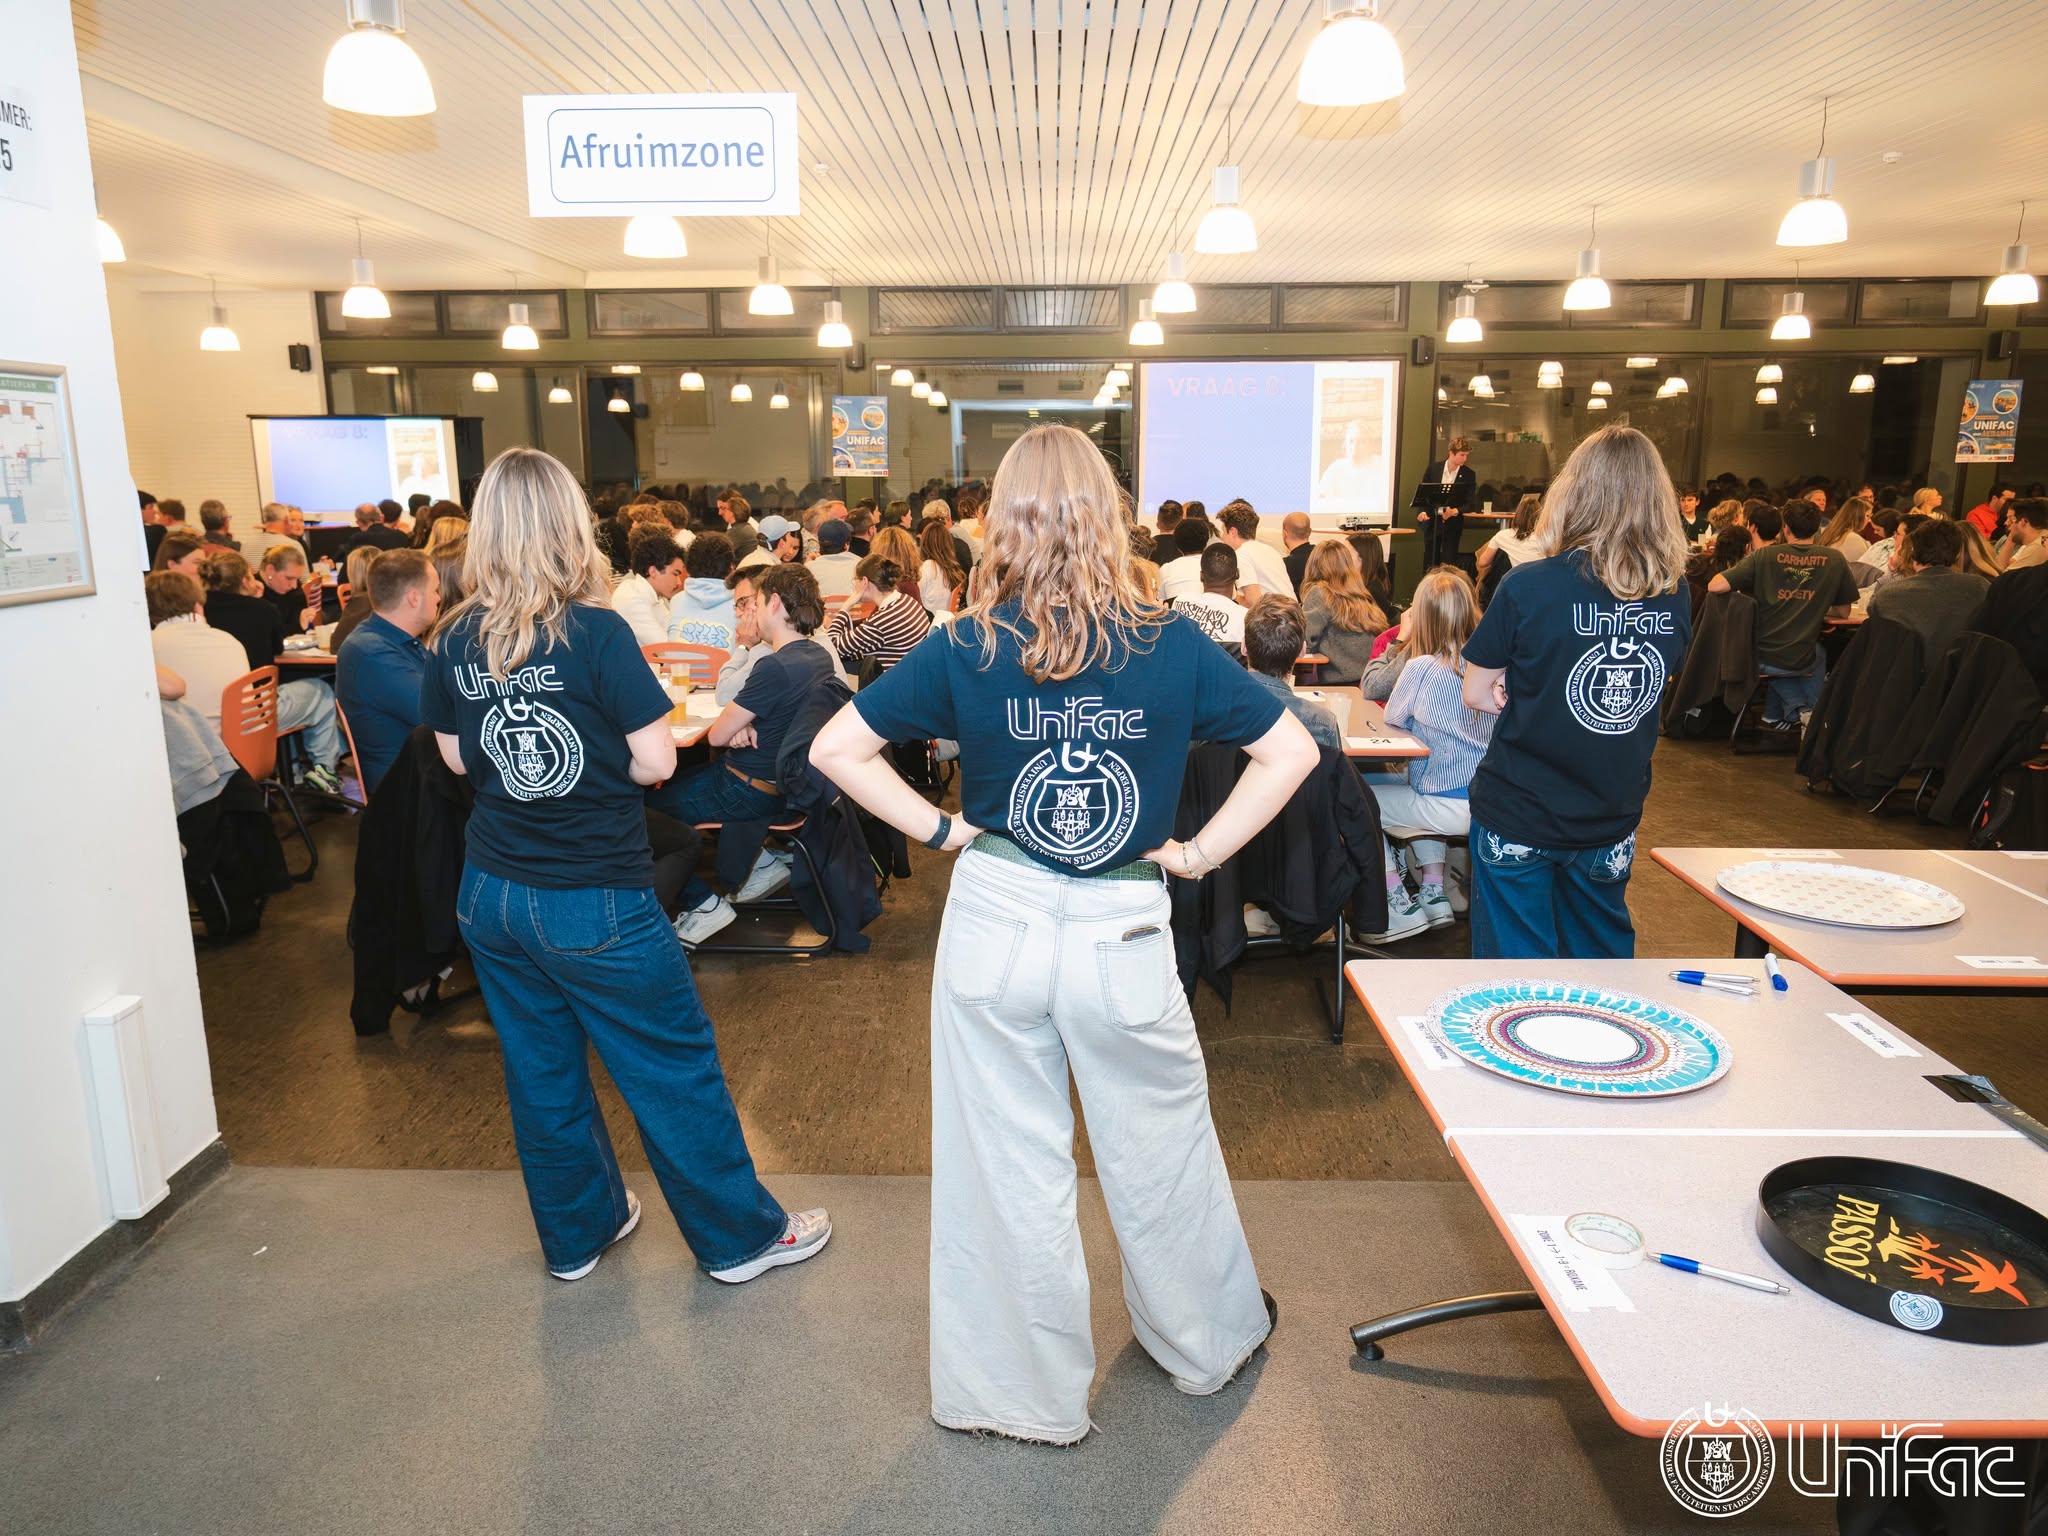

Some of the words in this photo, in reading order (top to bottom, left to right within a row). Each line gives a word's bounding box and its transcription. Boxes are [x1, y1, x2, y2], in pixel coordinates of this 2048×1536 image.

[0, 99, 33, 132] MER:
[560, 132, 765, 169] Afruimzone
[1168, 376, 1257, 397] VRAAG
[846, 436, 885, 445] UNIFAC
[1973, 421, 2015, 430] UNIFAC
[1777, 553, 1828, 567] CARHARTT
[1570, 650, 1600, 703] UNIVERSITAIRE
[540, 711, 579, 753] ANTWERPEN
[1007, 696, 1147, 741] UniFac
[1573, 701, 1616, 731] FACULTEITEN
[545, 754, 579, 798] STADSCAMPUS
[1013, 759, 1048, 828] UNIVERSITAIRE
[1073, 816, 1130, 865] STADSCAMPUS
[1108, 760, 1133, 816] ANTWERPEN
